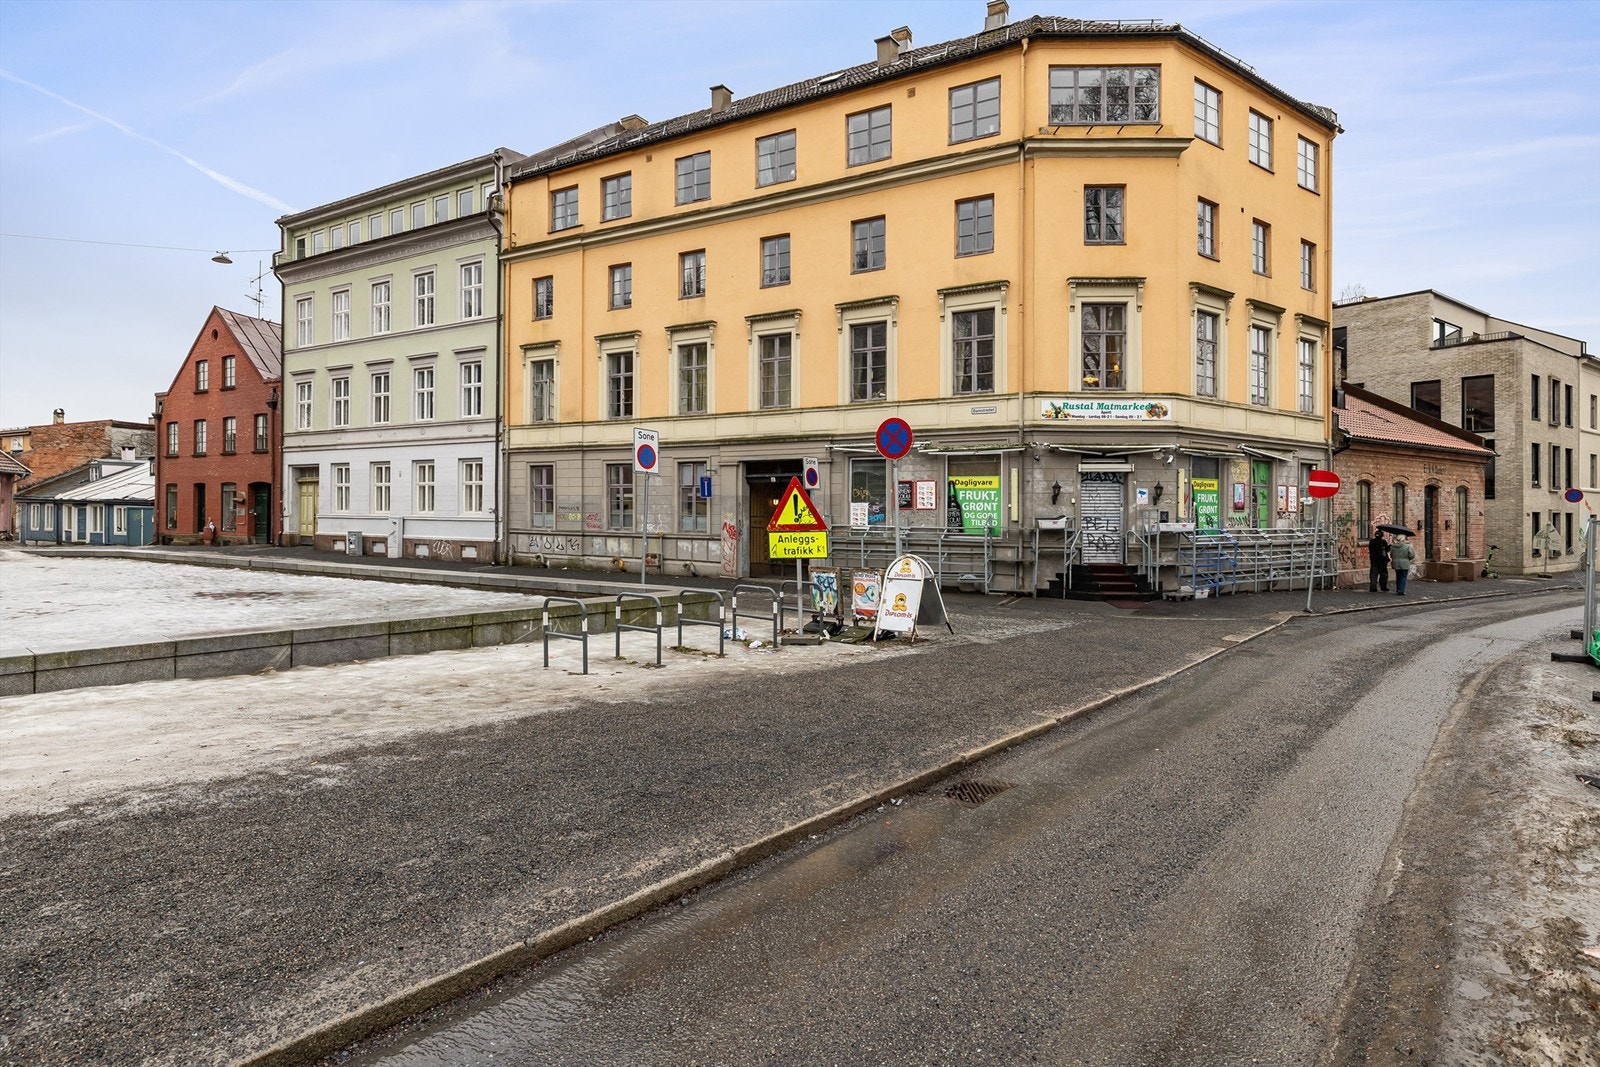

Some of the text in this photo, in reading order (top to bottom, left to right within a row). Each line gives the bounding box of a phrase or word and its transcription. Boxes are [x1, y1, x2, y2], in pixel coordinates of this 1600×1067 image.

[1062, 402, 1151, 410] Rustal Matmarked
[638, 431, 654, 441] Sone
[955, 479, 992, 487] Dagligvare
[960, 491, 998, 501] FRUKT,
[1197, 494, 1218, 504] FRUKT,
[962, 502, 998, 511] GRØNT
[778, 535, 819, 545] Anleggs-
[784, 546, 813, 555] trafikk
